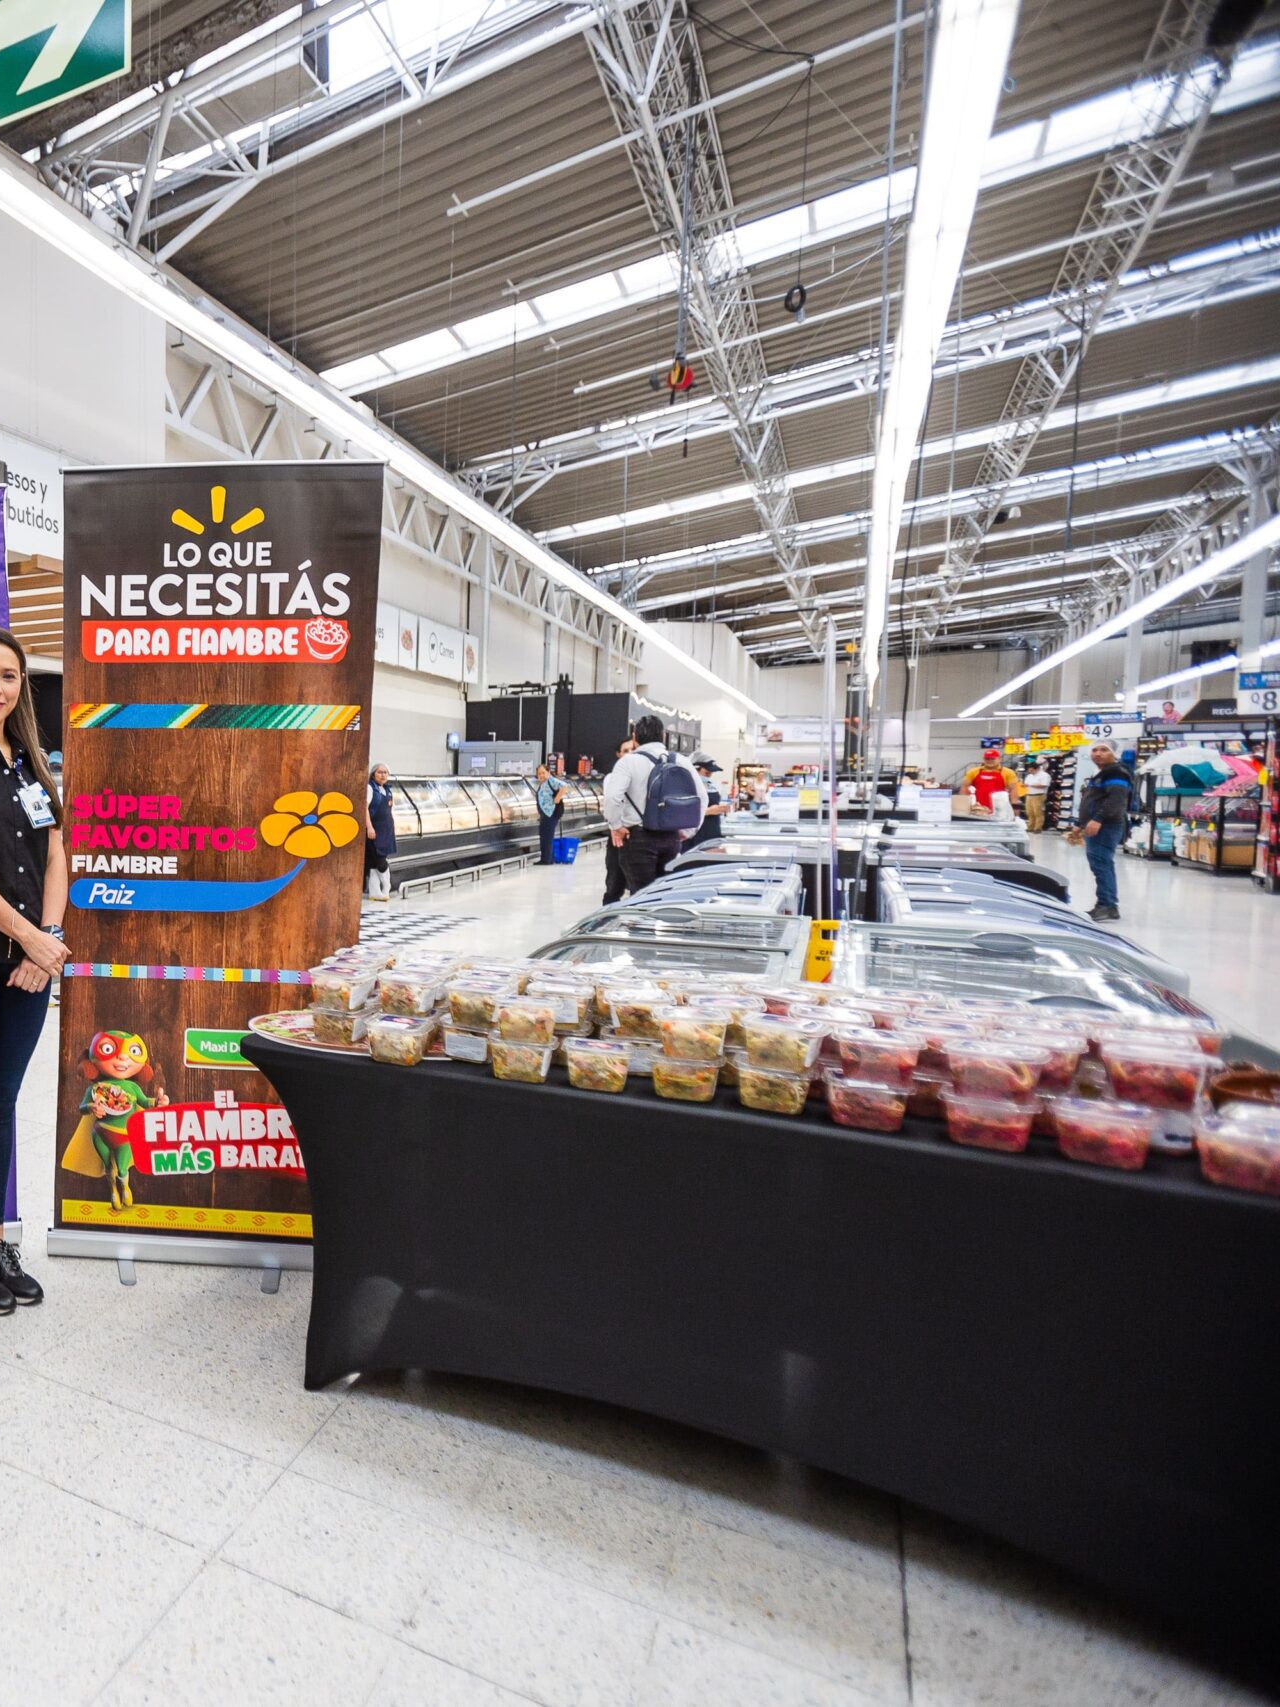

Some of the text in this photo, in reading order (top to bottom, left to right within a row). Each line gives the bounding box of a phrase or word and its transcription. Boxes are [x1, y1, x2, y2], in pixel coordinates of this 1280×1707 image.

[39, 481, 48, 504] y
[163, 541, 273, 569] LO QUE
[80, 559, 351, 617] NECESITÁS
[95, 627, 299, 656] PARA FIAMBRE
[72, 788, 182, 820] SÚPER
[71, 824, 257, 851] FAVORITOS
[71, 854, 178, 875] FIAMBRE
[88, 882, 135, 905] Paiz
[200, 1040, 227, 1053] Maxi
[214, 1090, 239, 1109] EL
[144, 1108, 296, 1143] FIAMBR
[151, 1143, 215, 1175] MÁS
